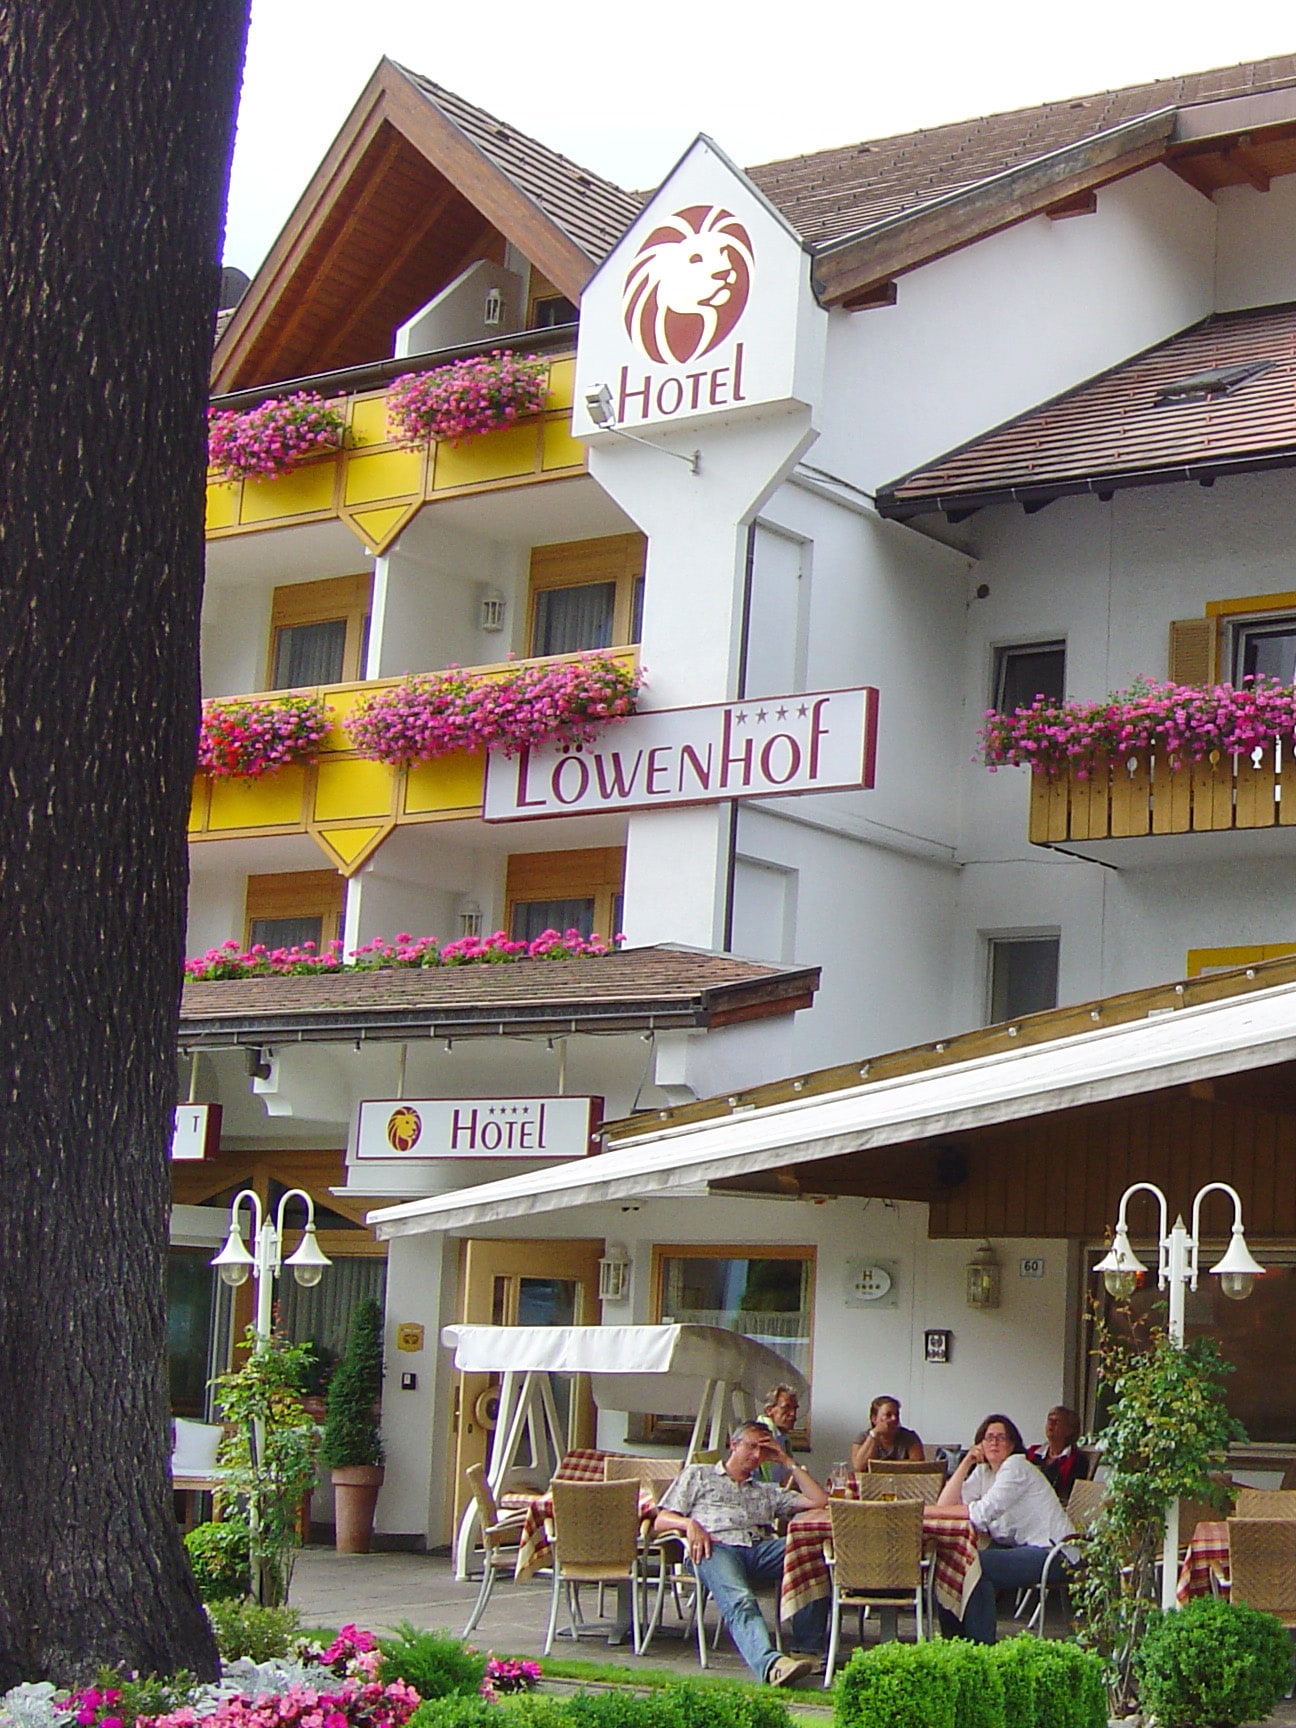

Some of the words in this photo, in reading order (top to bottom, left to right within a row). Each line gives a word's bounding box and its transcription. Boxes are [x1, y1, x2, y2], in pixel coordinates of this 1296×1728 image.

[617, 342, 746, 423] HOTEL
[516, 698, 831, 808] LÖWENHOF
[451, 1103, 547, 1151] HOTEL
[863, 1270, 873, 1281] H
[1024, 1260, 1039, 1272] 60
